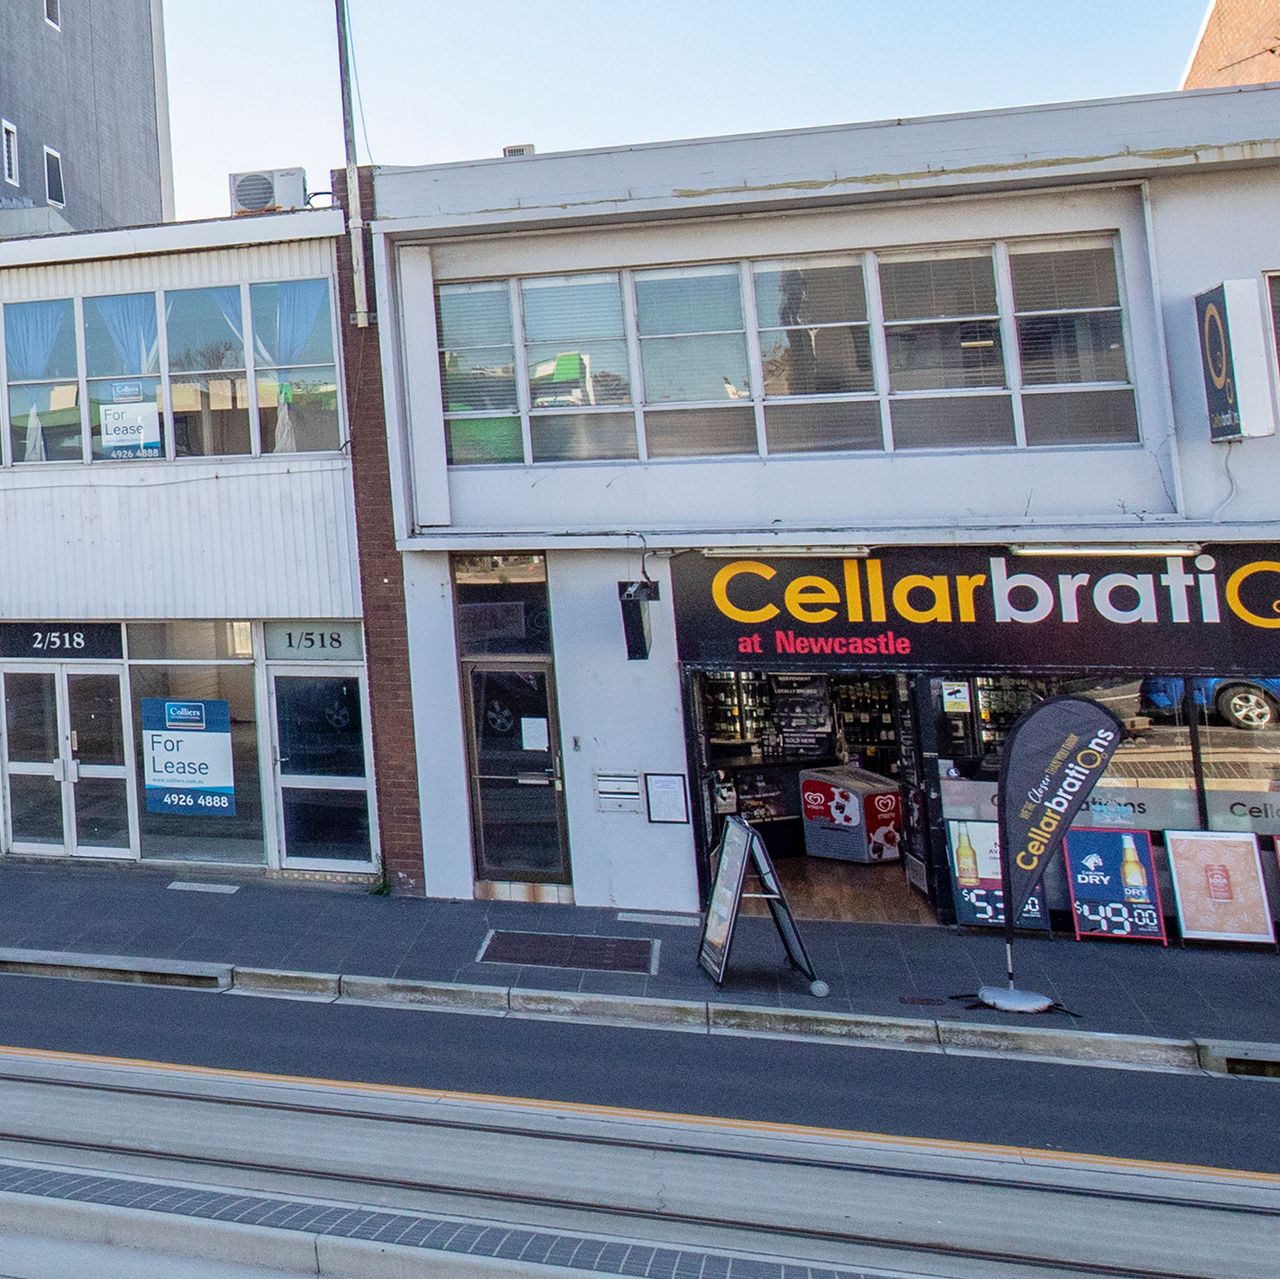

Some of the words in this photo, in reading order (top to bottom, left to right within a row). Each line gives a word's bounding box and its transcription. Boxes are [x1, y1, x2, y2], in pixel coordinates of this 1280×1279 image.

[104, 408, 126, 421] For
[105, 423, 144, 436] Lease
[110, 450, 134, 458] 4926
[136, 448, 159, 457] 4888
[32, 631, 85, 649] 2/518
[285, 631, 343, 649] 1/518
[738, 633, 762, 653] at
[775, 630, 911, 655] Newcastle
[169, 707, 201, 717] Colliers
[151, 734, 184, 752] For
[152, 756, 209, 775] Lease
[1027, 774, 1052, 804] Closer
[163, 793, 194, 806] 4926
[197, 795, 229, 808] 4888
[1077, 874, 1111, 885] DRY
[1124, 888, 1148, 896] DRY
